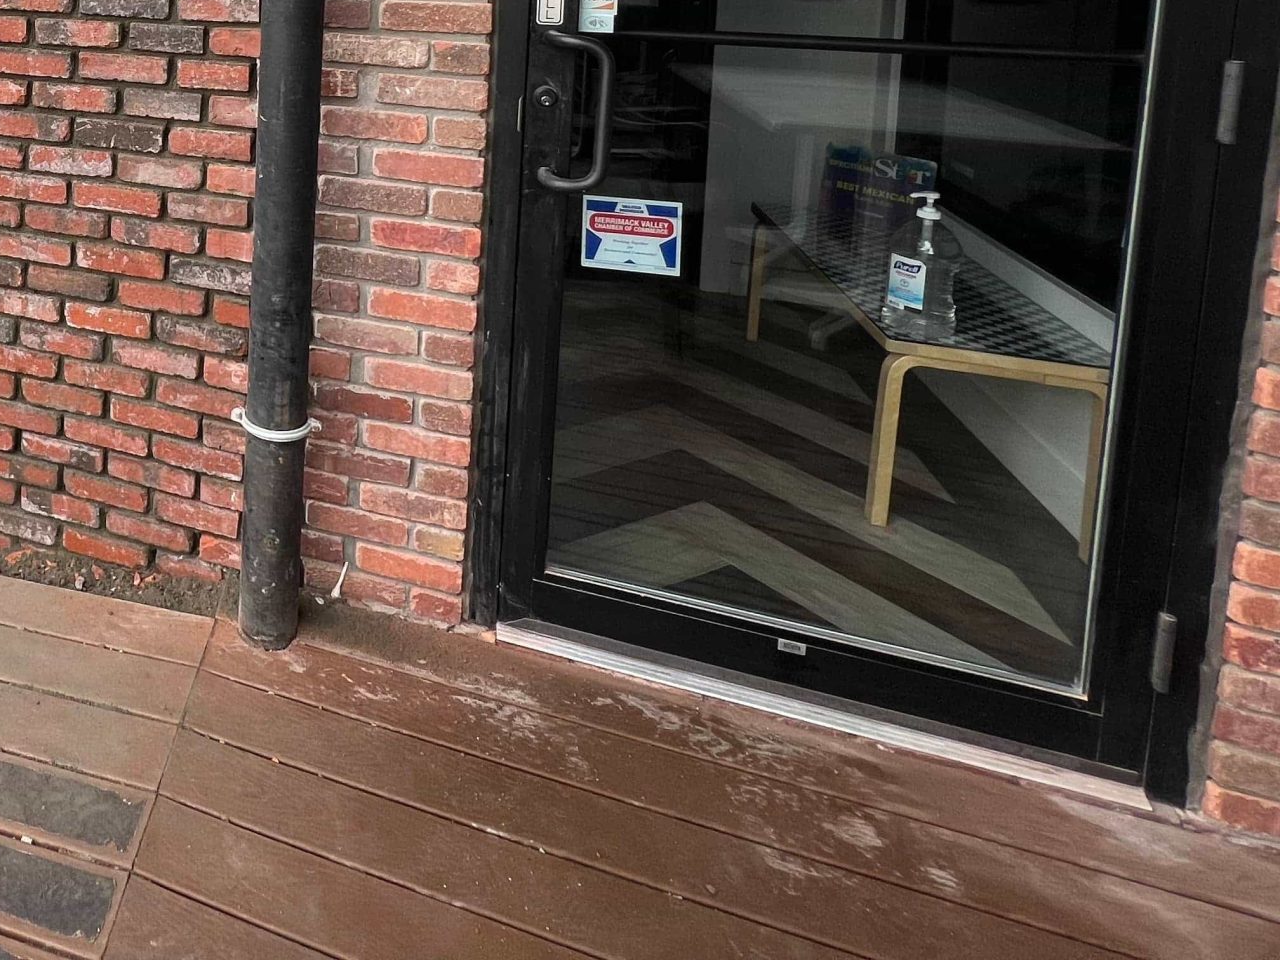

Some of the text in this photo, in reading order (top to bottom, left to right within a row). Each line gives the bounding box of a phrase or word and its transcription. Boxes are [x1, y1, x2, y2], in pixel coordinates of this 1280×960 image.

[836, 180, 860, 192] BEST
[862, 186, 916, 205] MEXICAN
[594, 216, 670, 229] MERRIMACK VALLEY
